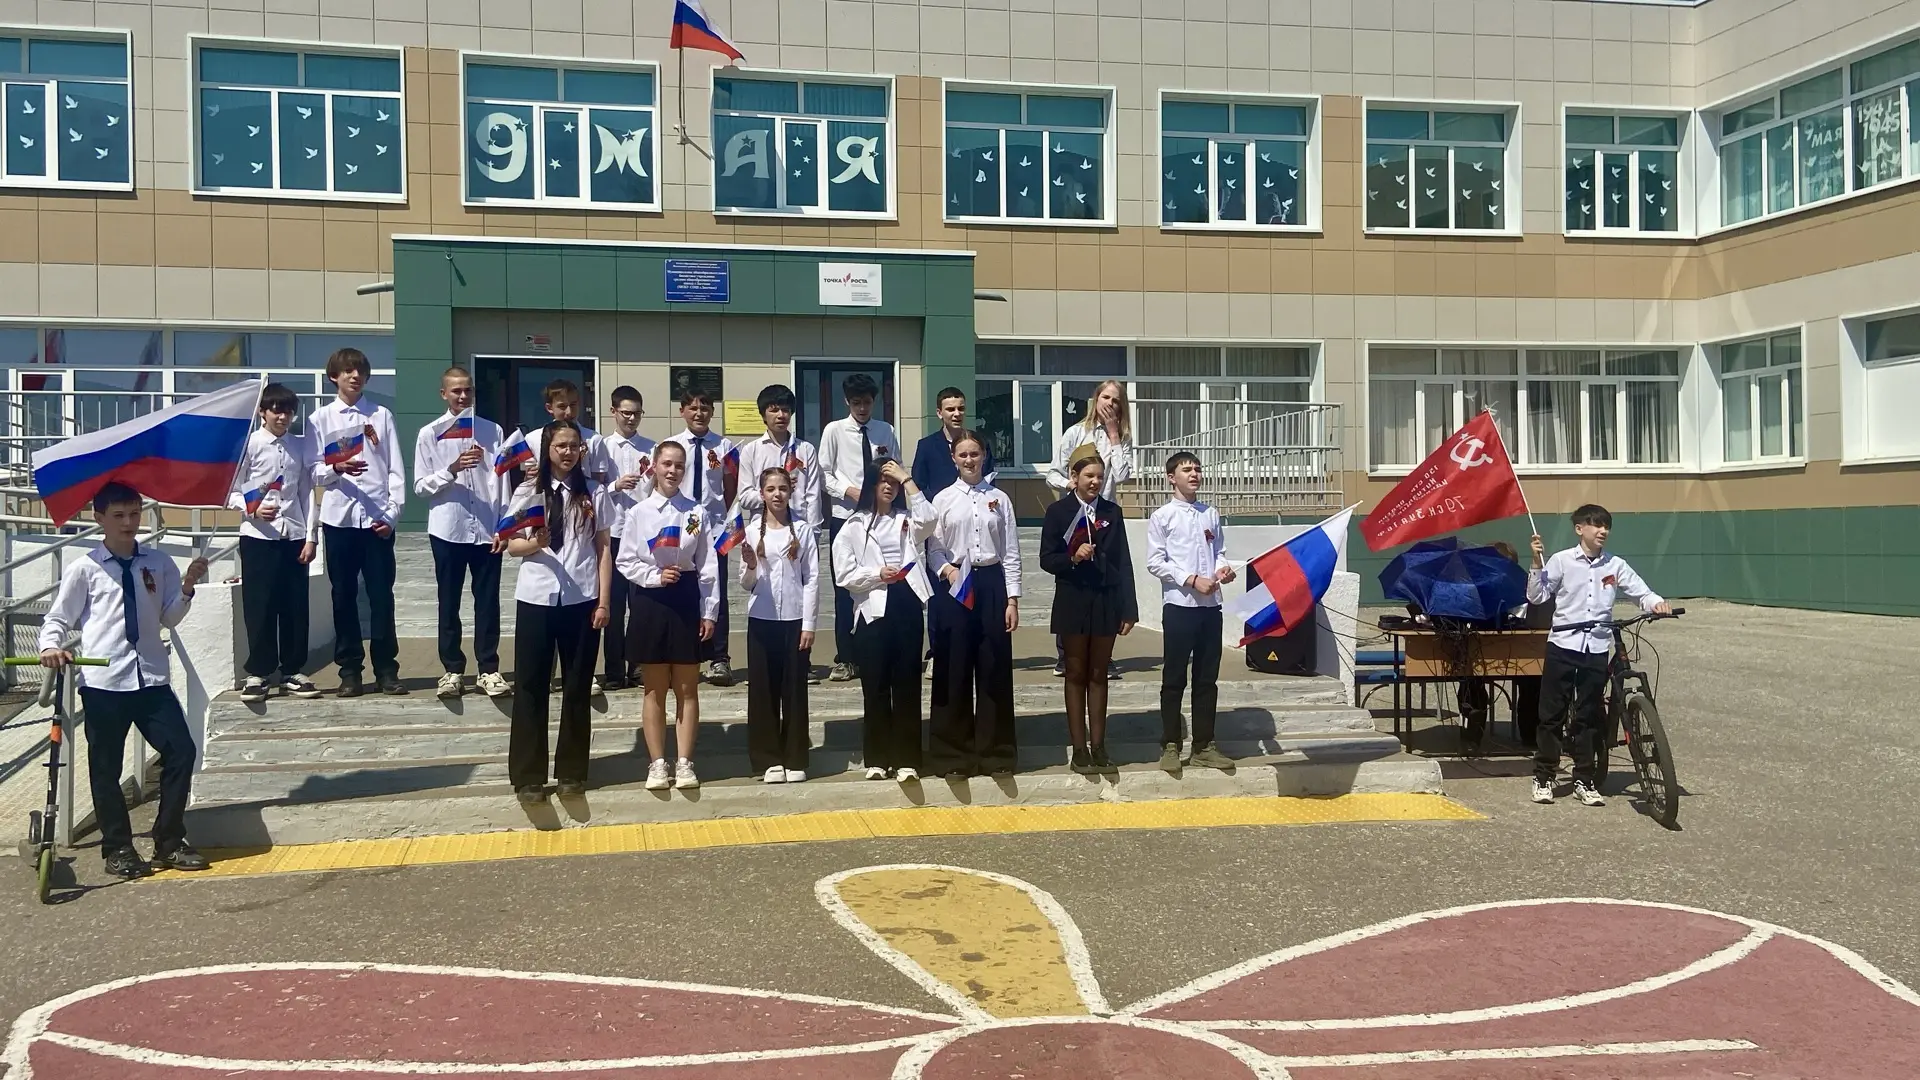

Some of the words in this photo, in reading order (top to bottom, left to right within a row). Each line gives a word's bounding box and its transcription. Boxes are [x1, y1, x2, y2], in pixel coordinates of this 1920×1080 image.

[1804, 121, 1815, 141] 9
[1811, 126, 1843, 149] МАЯ
[1862, 112, 1900, 140] 1945
[474, 112, 528, 183] 9
